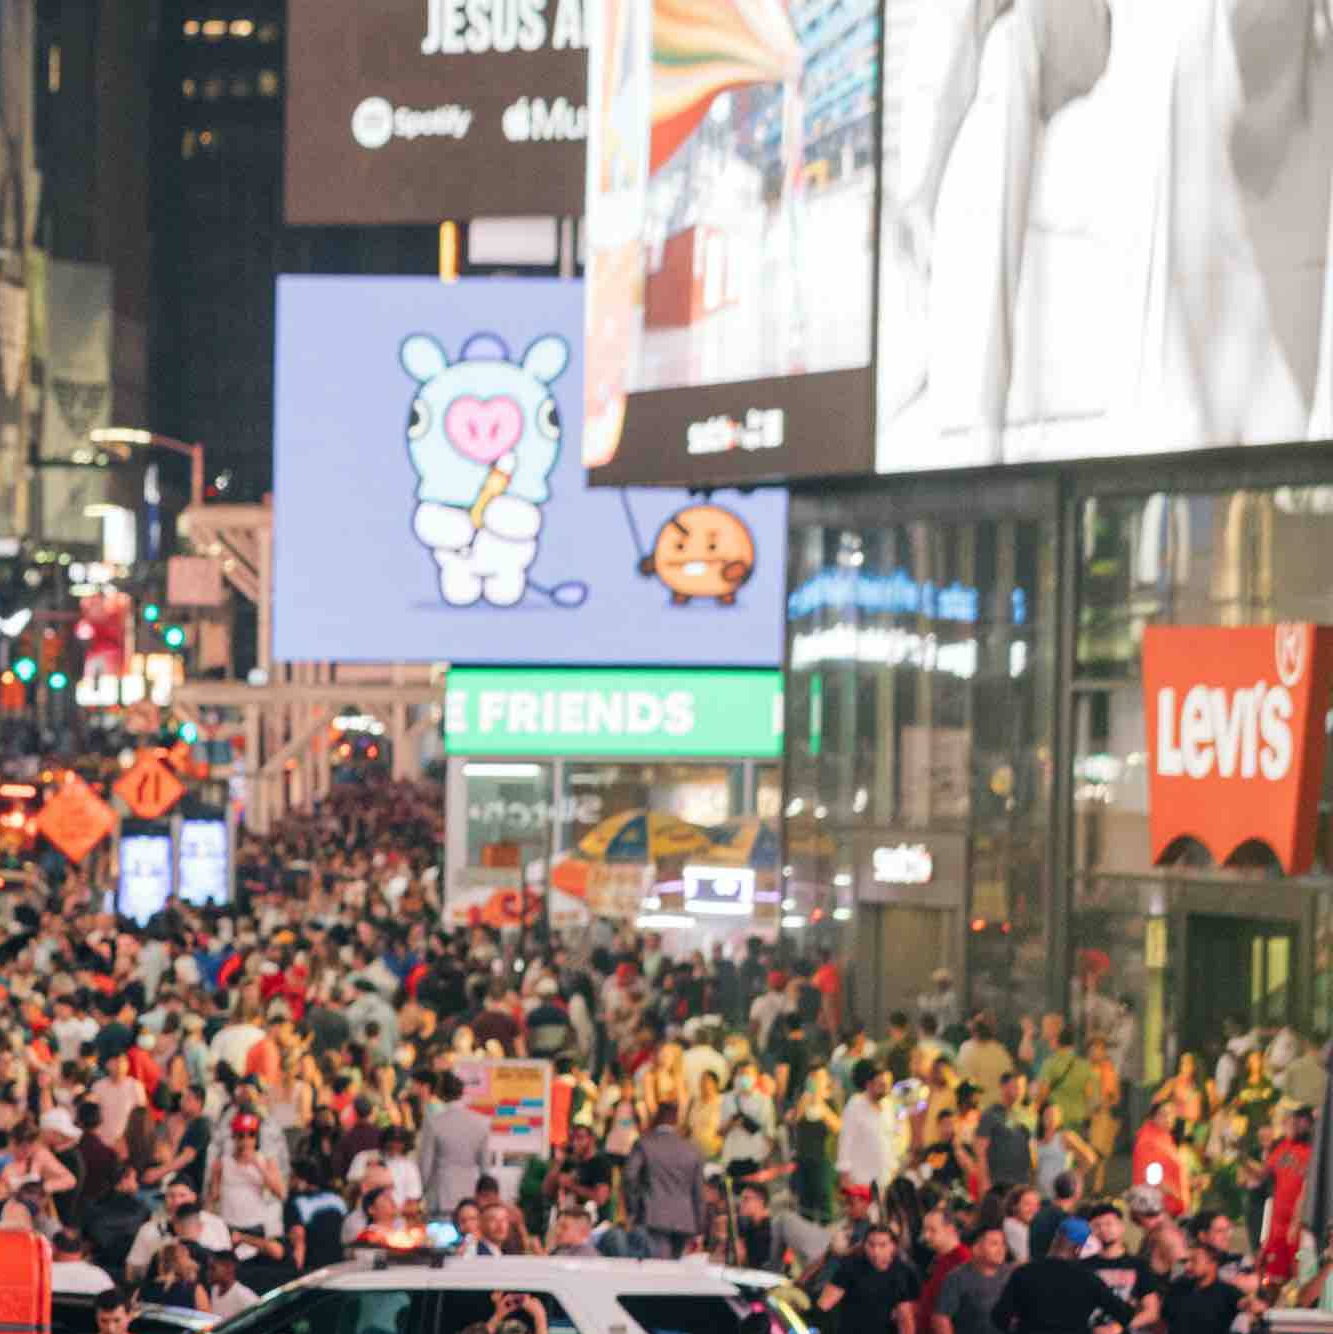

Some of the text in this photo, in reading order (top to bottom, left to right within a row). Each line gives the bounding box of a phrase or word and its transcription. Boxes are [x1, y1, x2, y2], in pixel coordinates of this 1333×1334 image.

[421, 0, 588, 54] JESUS A
[394, 103, 473, 139] Spotify
[479, 690, 695, 734] FRIENDS
